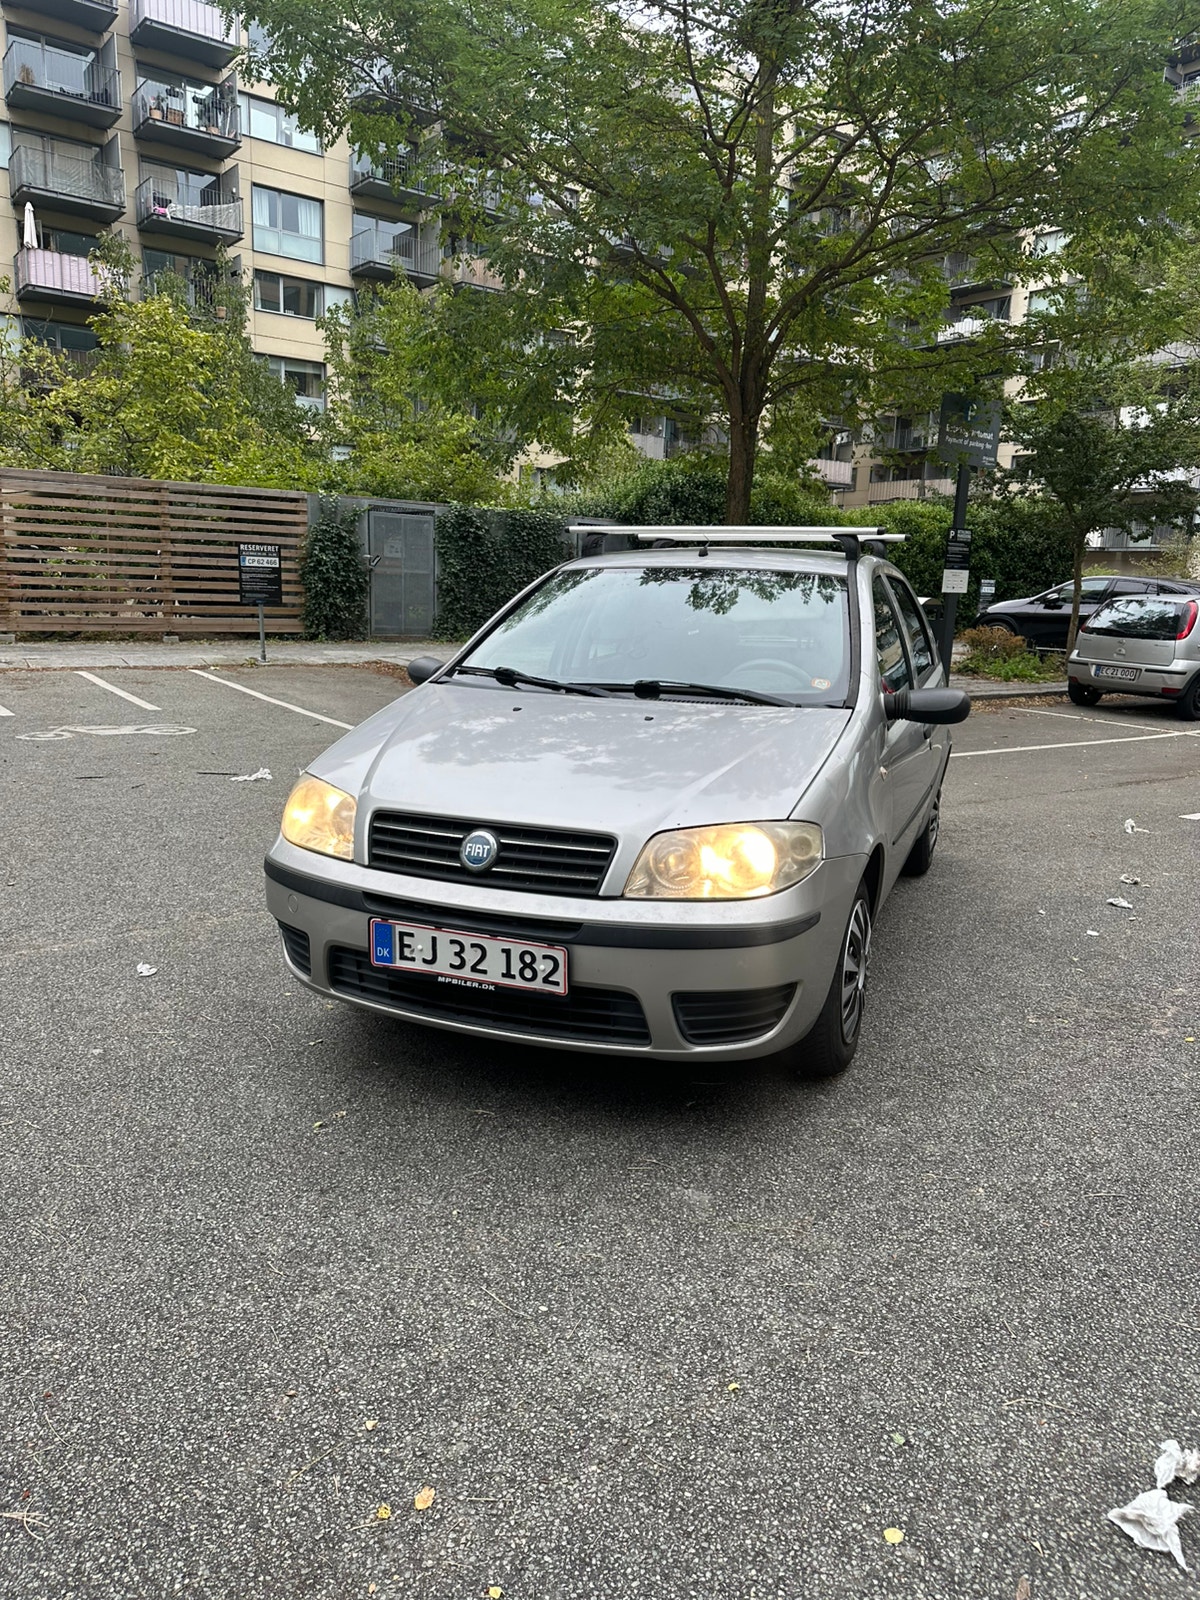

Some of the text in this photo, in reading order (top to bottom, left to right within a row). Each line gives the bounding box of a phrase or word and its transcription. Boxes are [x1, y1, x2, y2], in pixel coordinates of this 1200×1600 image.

[969, 440, 984, 450] parking
[949, 530, 956, 539] P
[240, 544, 279, 552] RESERVERET
[265, 558, 278, 566] 466
[1101, 666, 1110, 675] EC
[1111, 668, 1118, 676] 21
[1120, 669, 1134, 678] 000
[465, 842, 491, 858] FIAT
[377, 947, 390, 958] DK
[398, 930, 560, 987] EJ 32 182
[437, 975, 496, 991] MPBILER.DK
